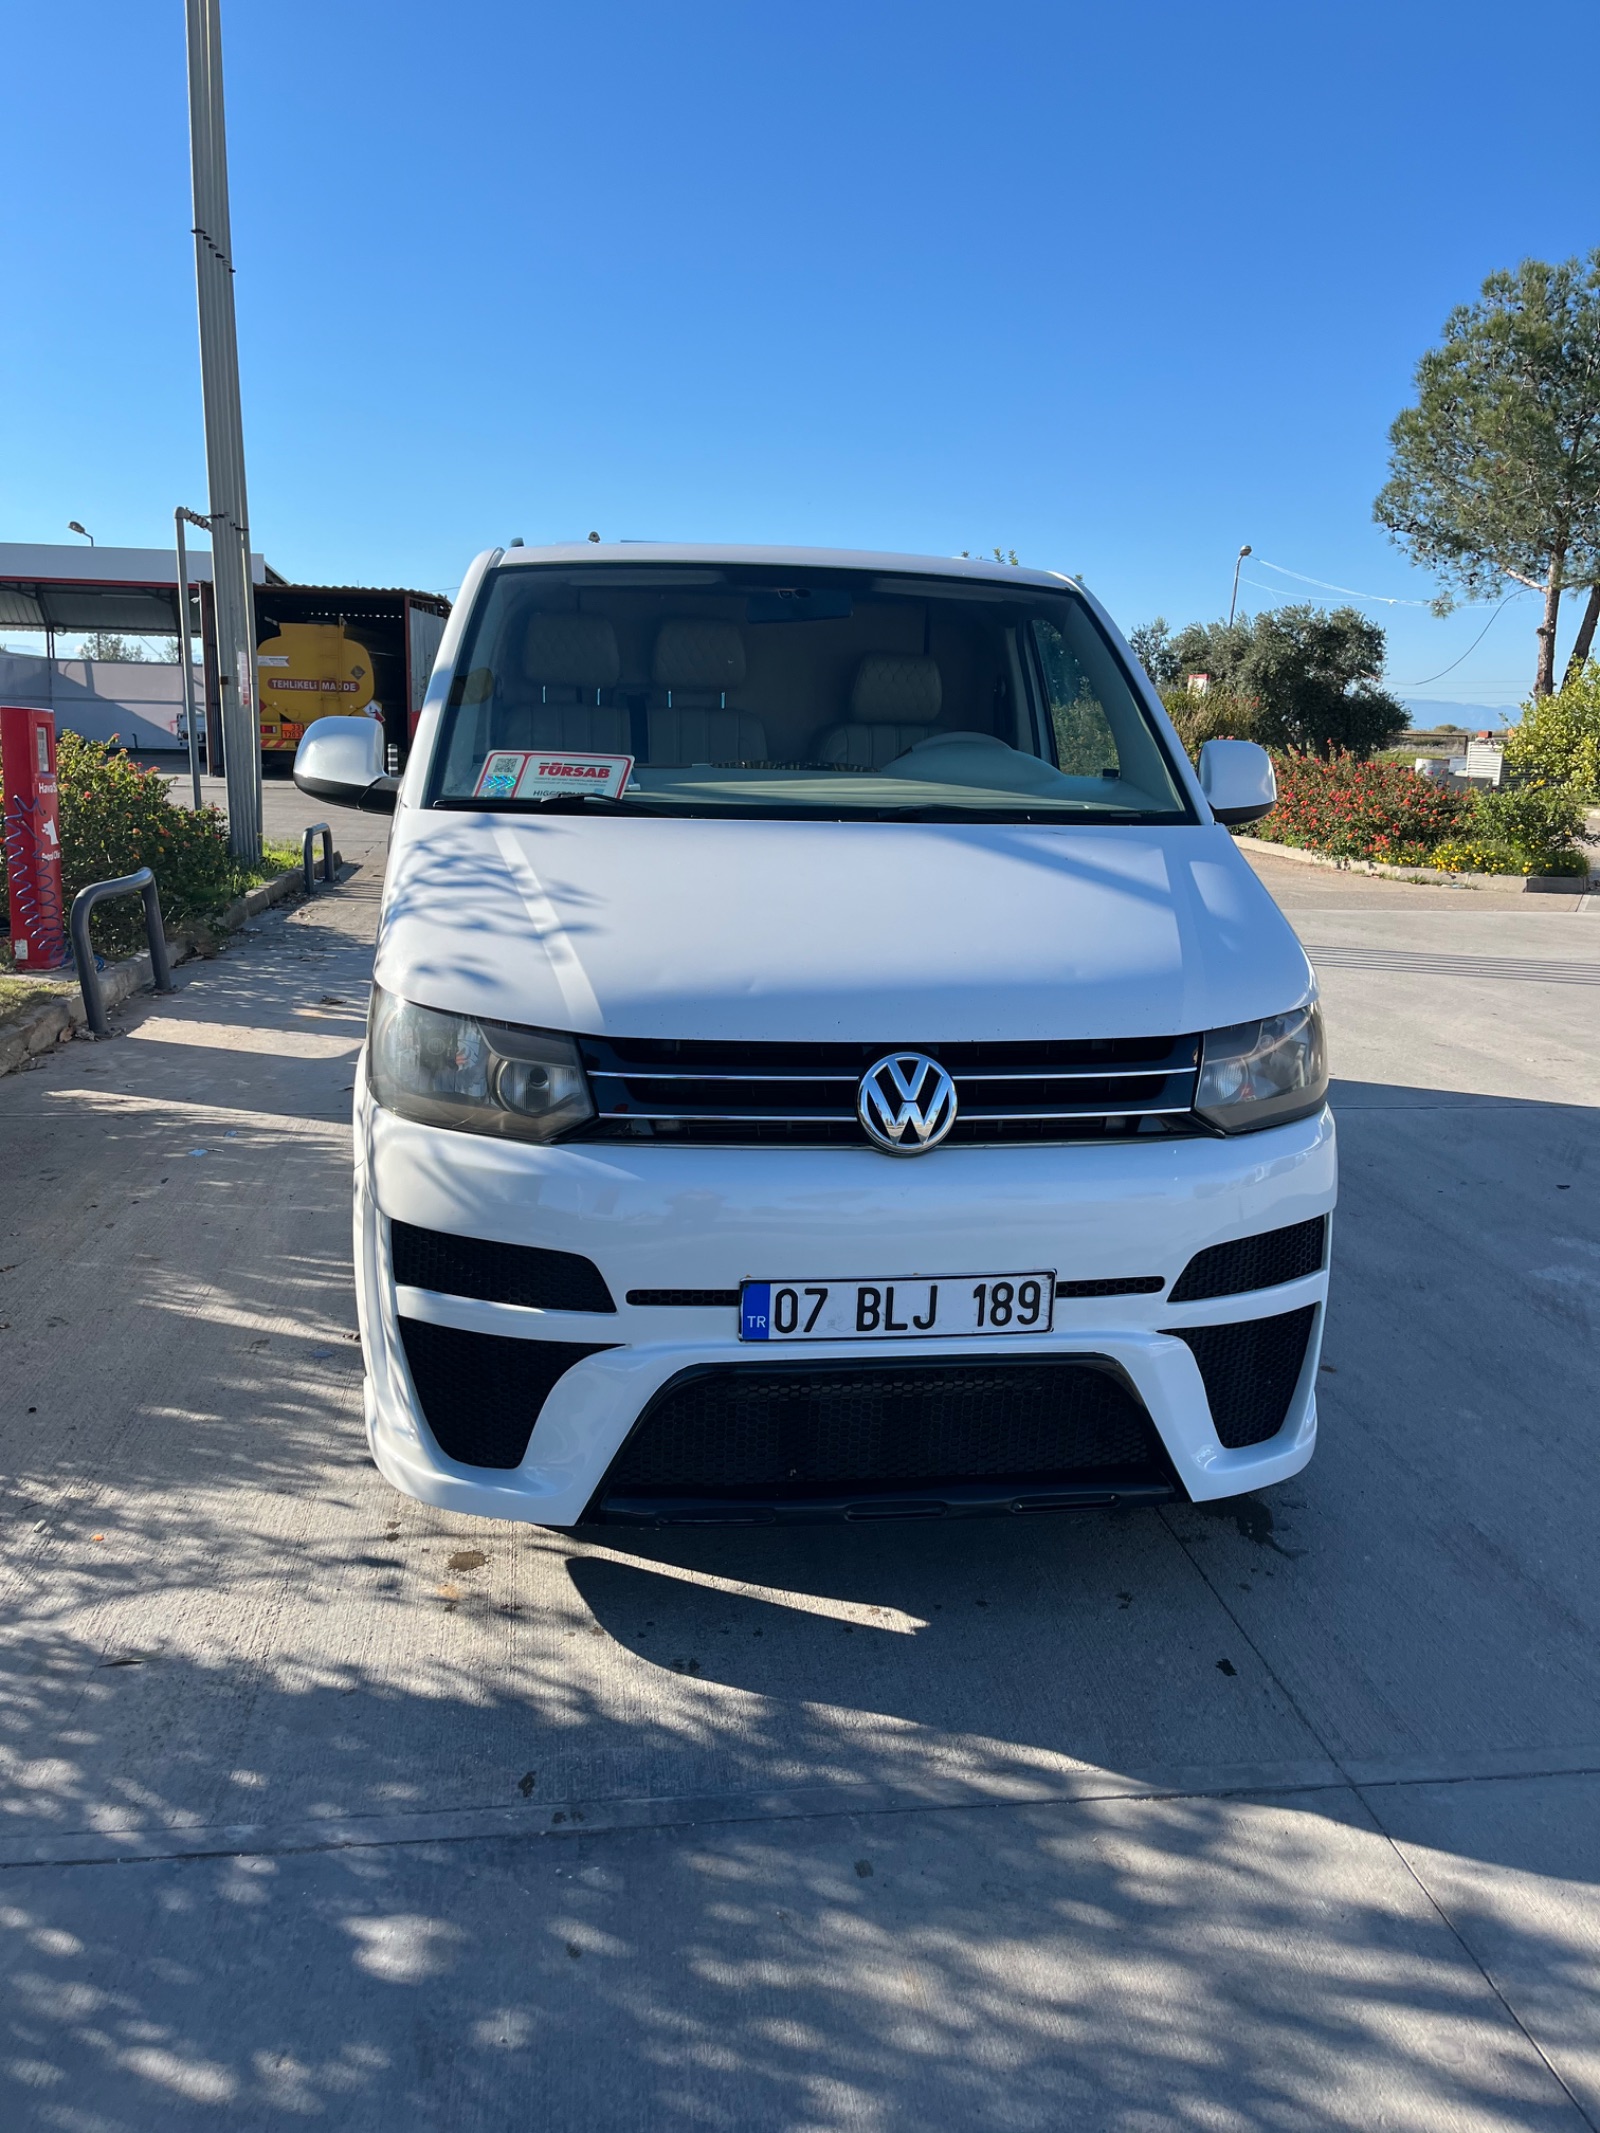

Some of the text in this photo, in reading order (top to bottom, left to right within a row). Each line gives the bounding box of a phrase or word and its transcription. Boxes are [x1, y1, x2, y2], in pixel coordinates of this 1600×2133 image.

[538, 762, 610, 778] TÜRSAB
[747, 1280, 1041, 1333] TR 07 BLJ 189
